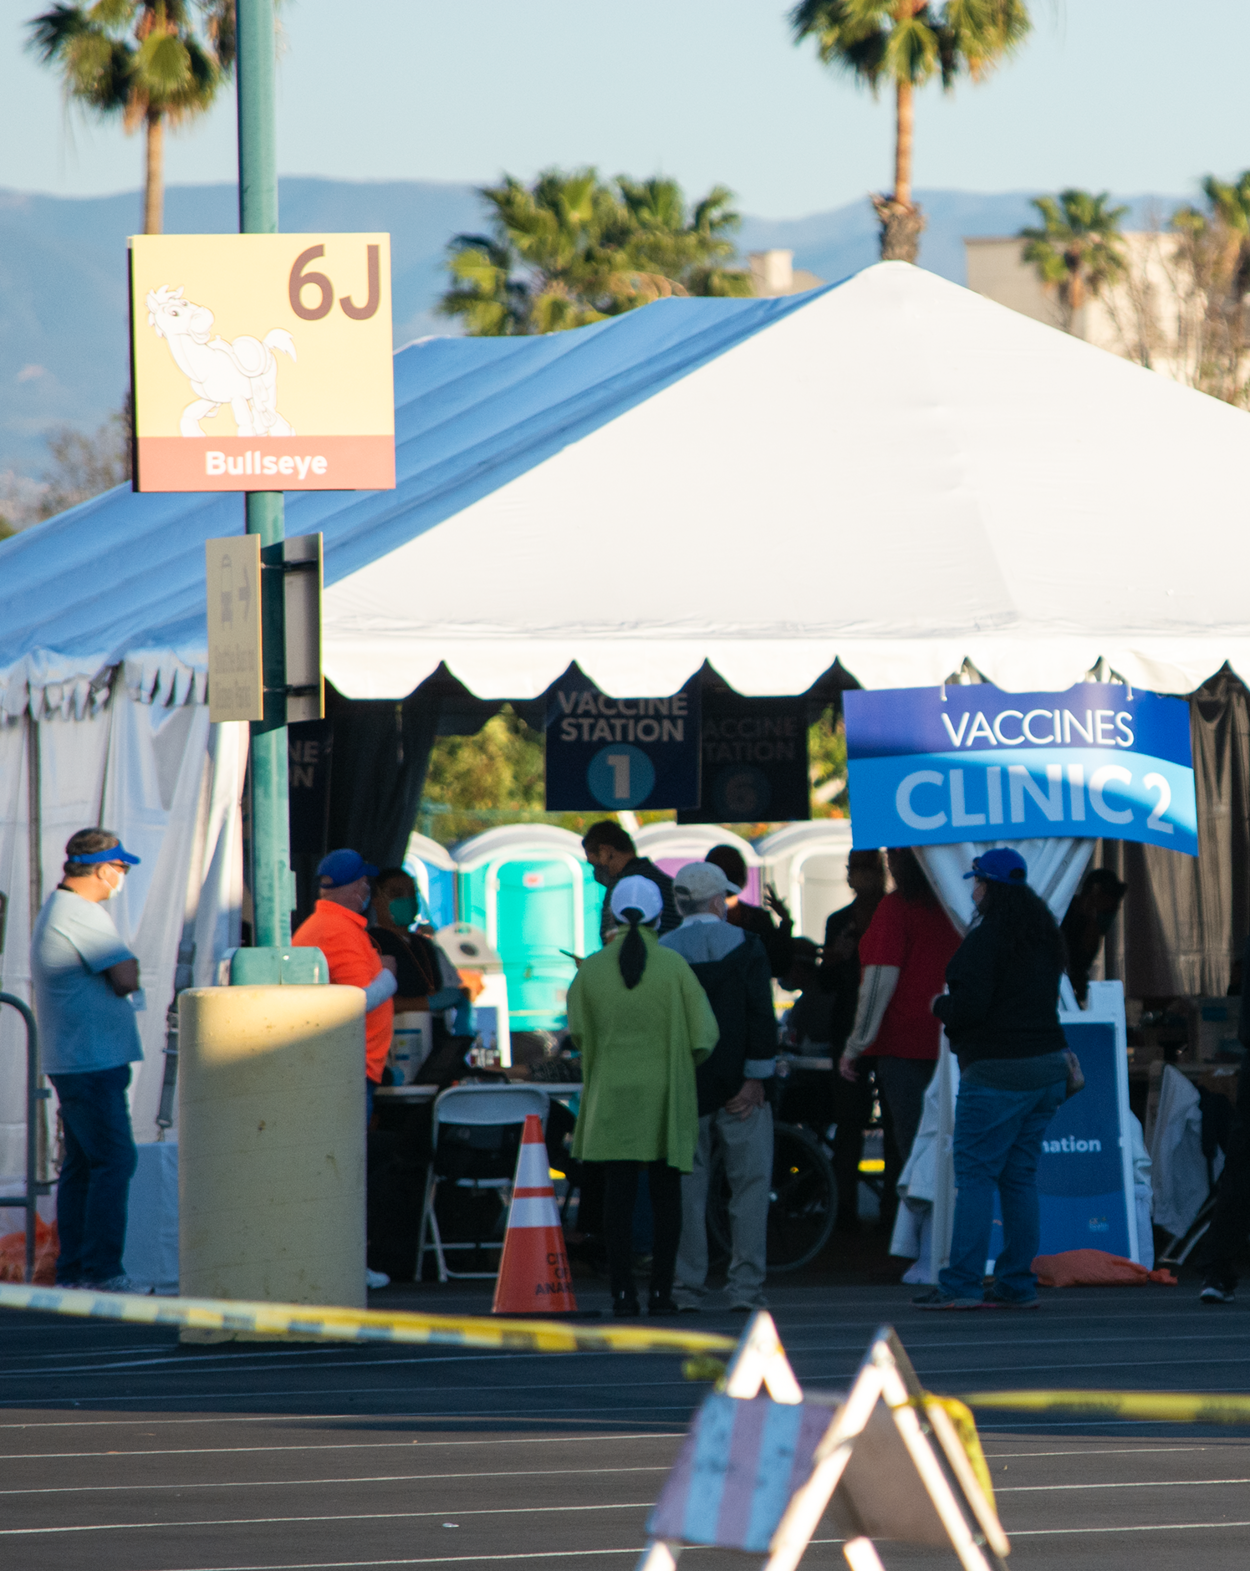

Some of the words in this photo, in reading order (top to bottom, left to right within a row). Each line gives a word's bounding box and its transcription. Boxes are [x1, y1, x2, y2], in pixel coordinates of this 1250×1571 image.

[288, 243, 381, 321] 6J
[205, 450, 328, 480] Bullseye
[557, 690, 688, 716] VACCINE
[560, 717, 685, 742] STATION
[703, 717, 798, 738] ACCINE
[940, 709, 1135, 748] VACCINES
[703, 742, 795, 761] TATION
[606, 754, 631, 800] 1
[895, 763, 1135, 831] CLINIC
[1142, 772, 1175, 835] 2
